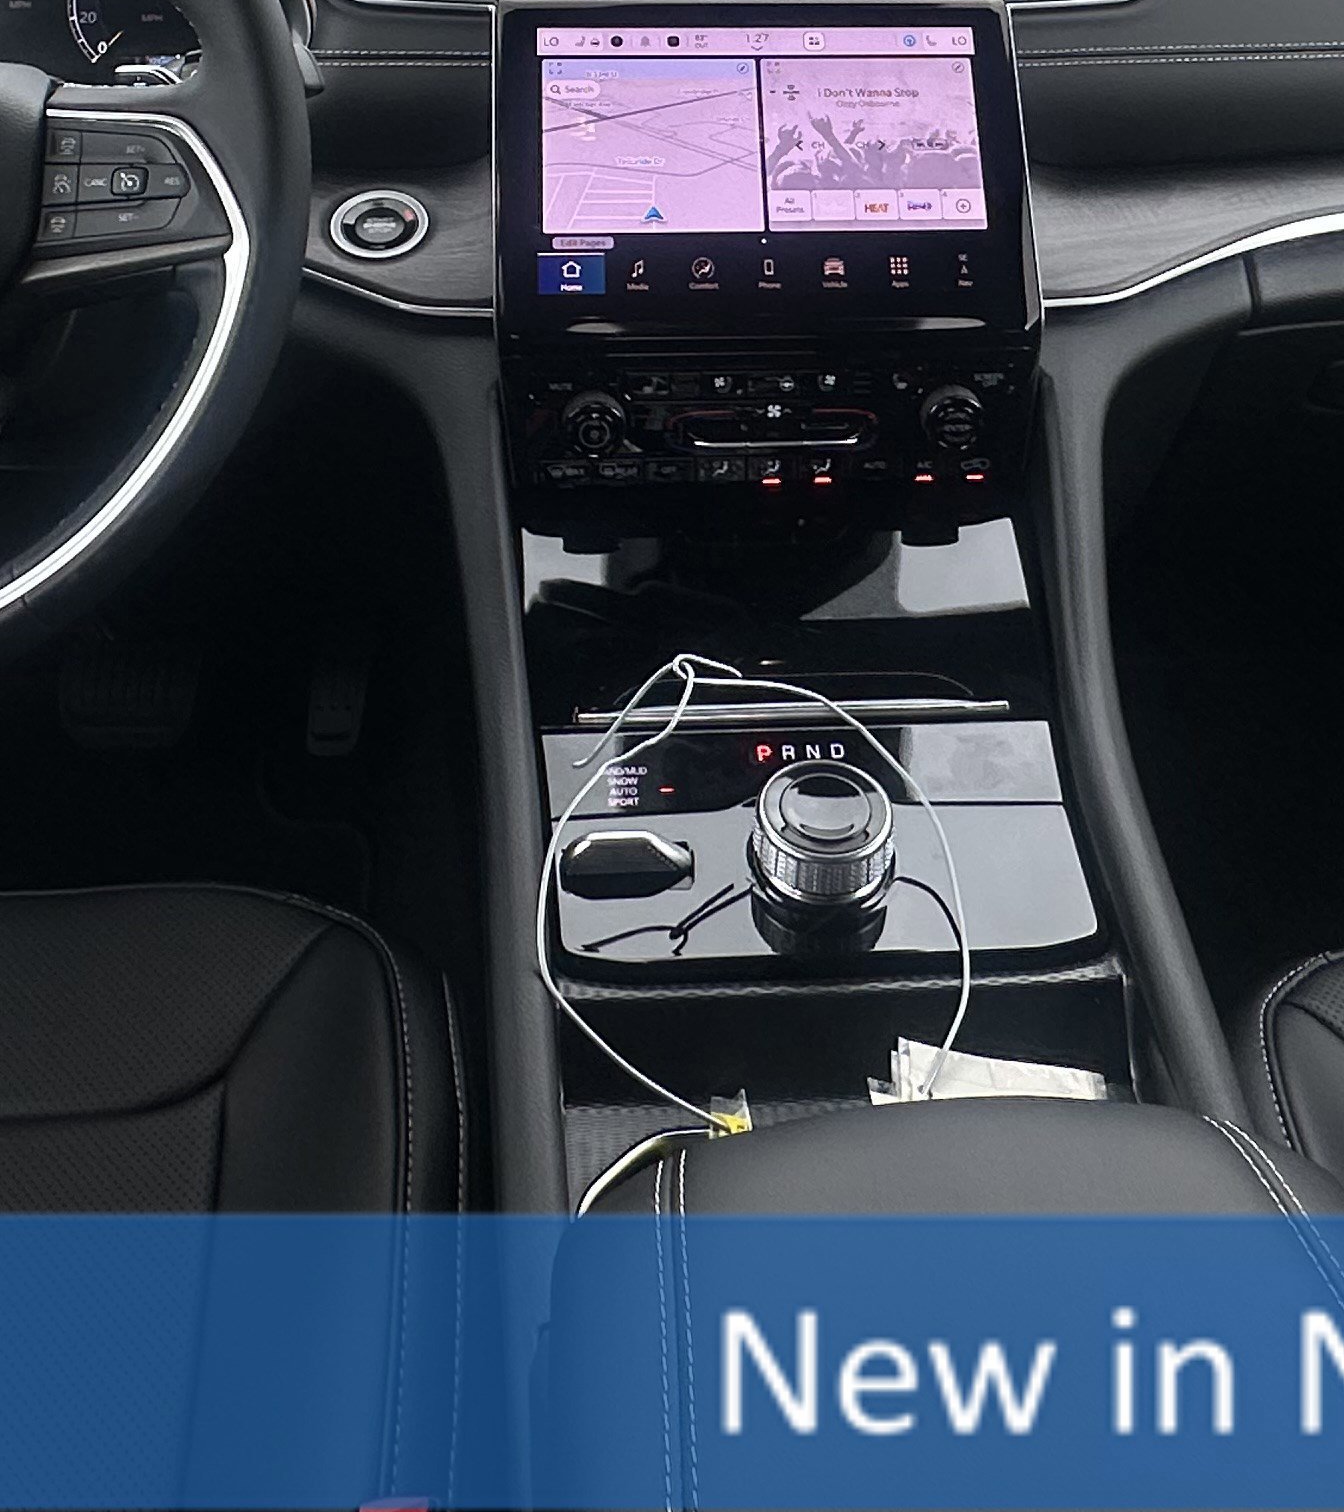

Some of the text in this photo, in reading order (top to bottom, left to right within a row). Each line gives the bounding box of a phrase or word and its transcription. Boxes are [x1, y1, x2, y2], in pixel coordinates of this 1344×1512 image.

[79, 11, 97, 24] 20
[97, 40, 108, 54] 0
[564, 85, 595, 94] Search
[823, 87, 853, 98] Don't
[855, 88, 892, 98] Wanna
[894, 87, 920, 99] Stop
[864, 203, 890, 213] HEAT
[757, 743, 845, 762] P R N D
[607, 776, 639, 786] SNOW
[609, 786, 638, 796] AUTO
[607, 796, 640, 807] SPORT
